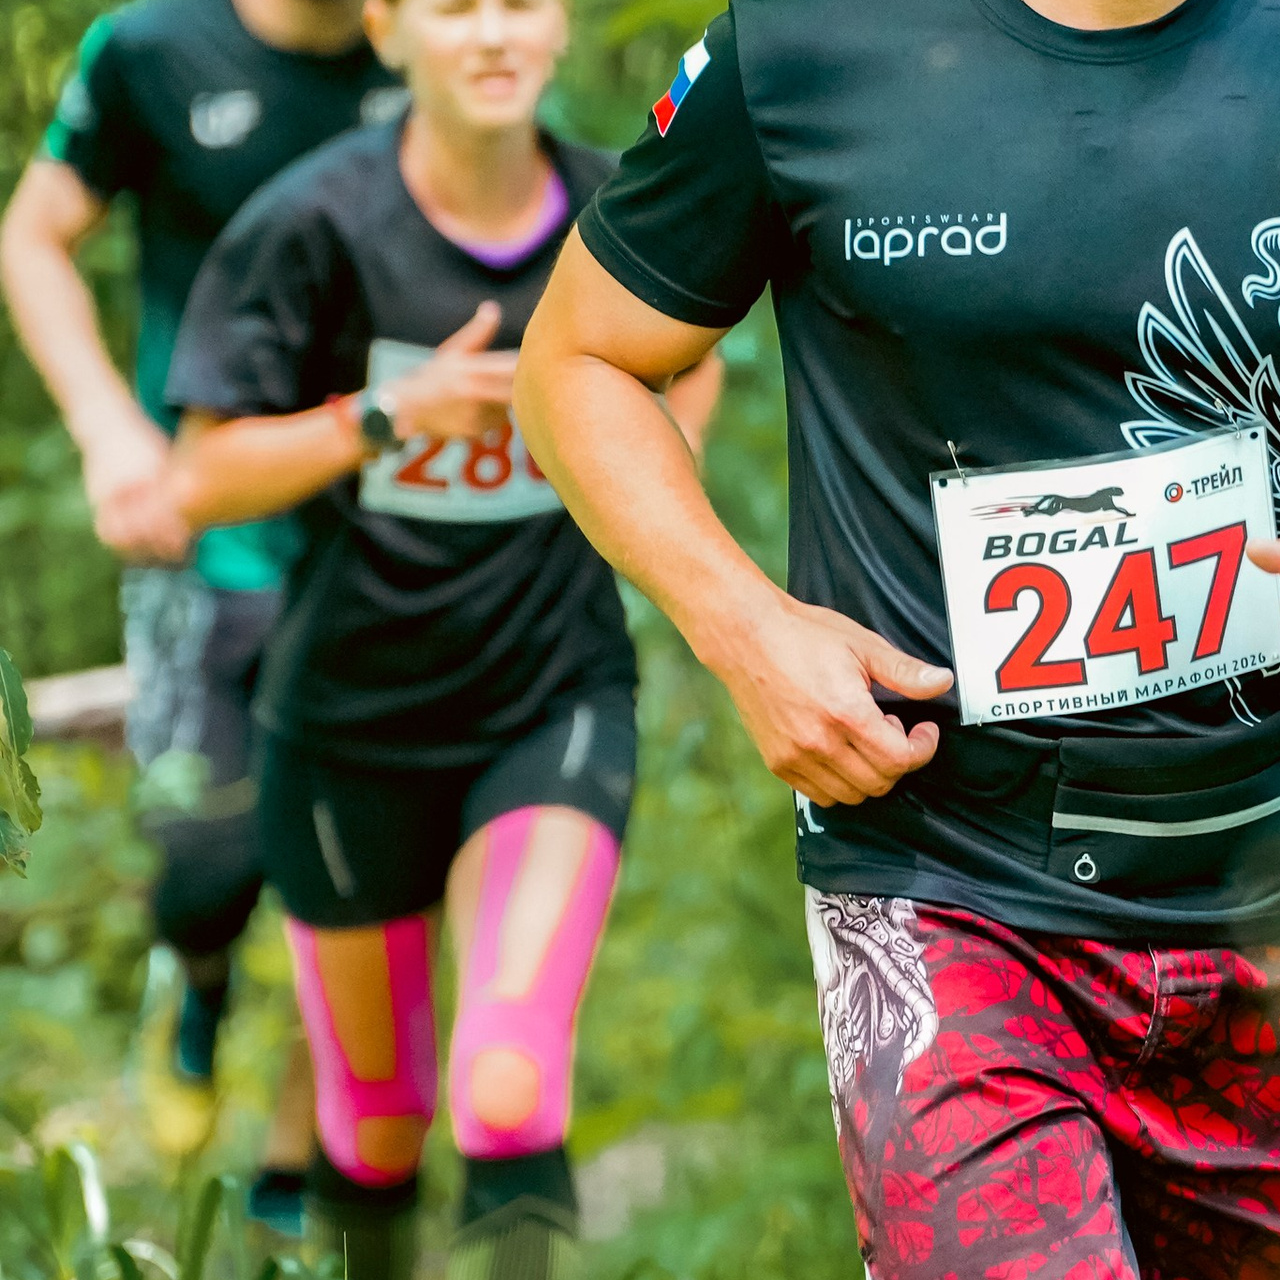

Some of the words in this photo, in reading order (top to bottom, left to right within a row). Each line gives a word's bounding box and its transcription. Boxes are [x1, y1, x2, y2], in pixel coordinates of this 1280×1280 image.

[845, 212, 1007, 266] laprad
[856, 213, 994, 228] SPORTSWEAR
[392, 421, 550, 491] 28
[982, 521, 1139, 561] BOGAL
[984, 521, 1248, 694] 247
[991, 688, 1129, 717] СПОРТИВНЫЙ
[1135, 664, 1227, 700] МАРАФОН
[1232, 652, 1267, 672] 2026
